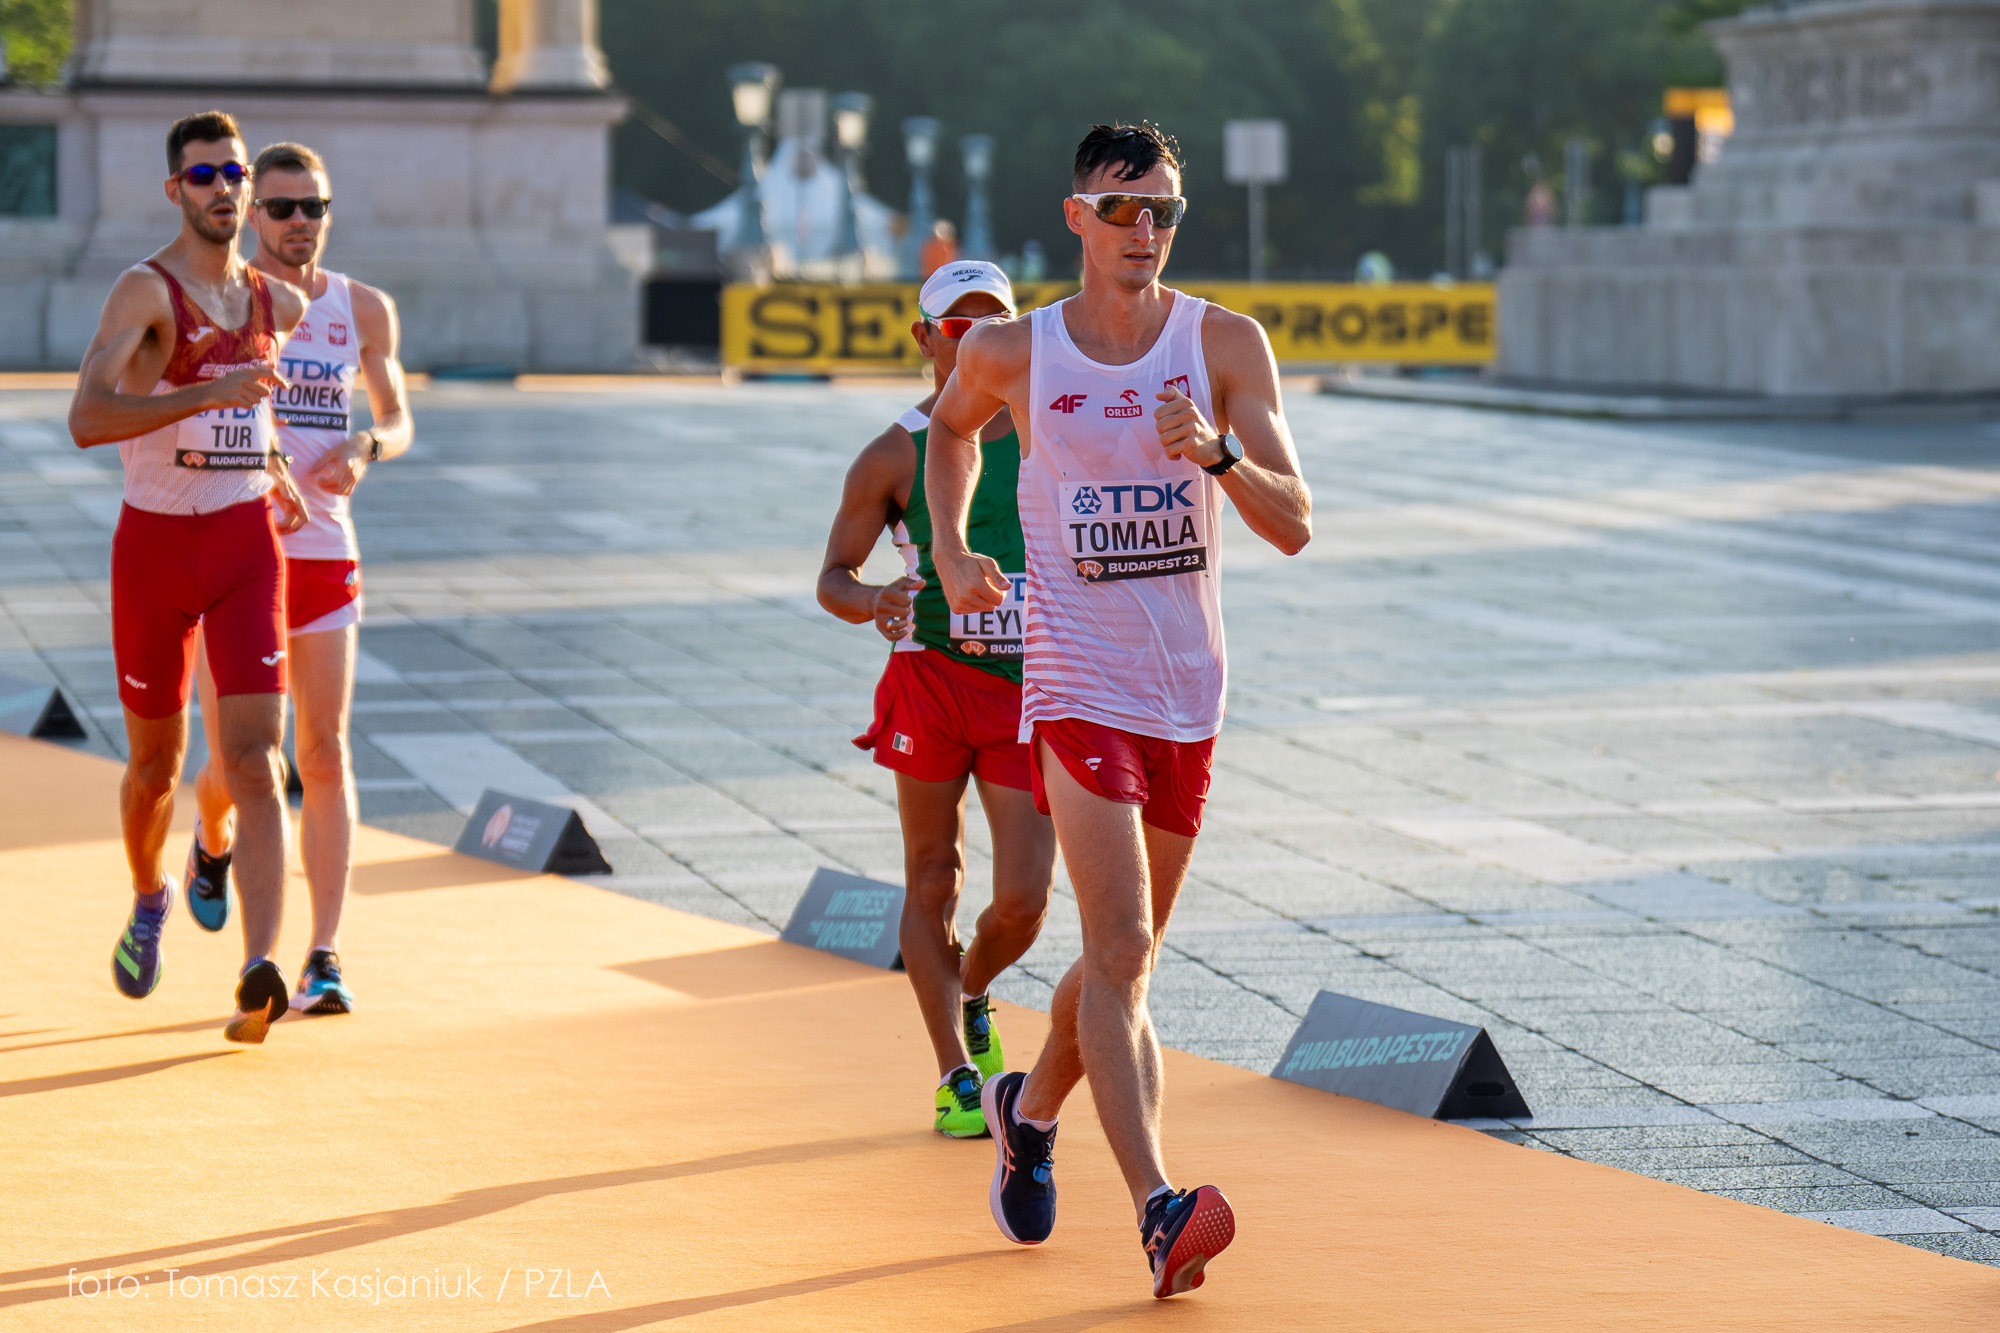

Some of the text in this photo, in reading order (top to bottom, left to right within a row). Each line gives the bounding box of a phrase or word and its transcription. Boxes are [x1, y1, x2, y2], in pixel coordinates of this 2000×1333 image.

[952, 268, 984, 276] MEXICO
[281, 357, 345, 382] TDK
[1049, 394, 1088, 414] 4F
[1106, 406, 1140, 417] ORLEN
[332, 415, 344, 425] 23
[211, 424, 252, 448] TUR
[209, 455, 260, 466] BUDAPEST
[1101, 480, 1195, 513] TDK
[1069, 515, 1198, 553] TOMALA
[1108, 554, 1199, 573] BUDAPEST 23
[990, 644, 1024, 654] BUDA
[823, 889, 896, 917] WITNESS
[815, 920, 886, 949] WONDER
[1282, 1030, 1465, 1077] #WABUDAPEST23
